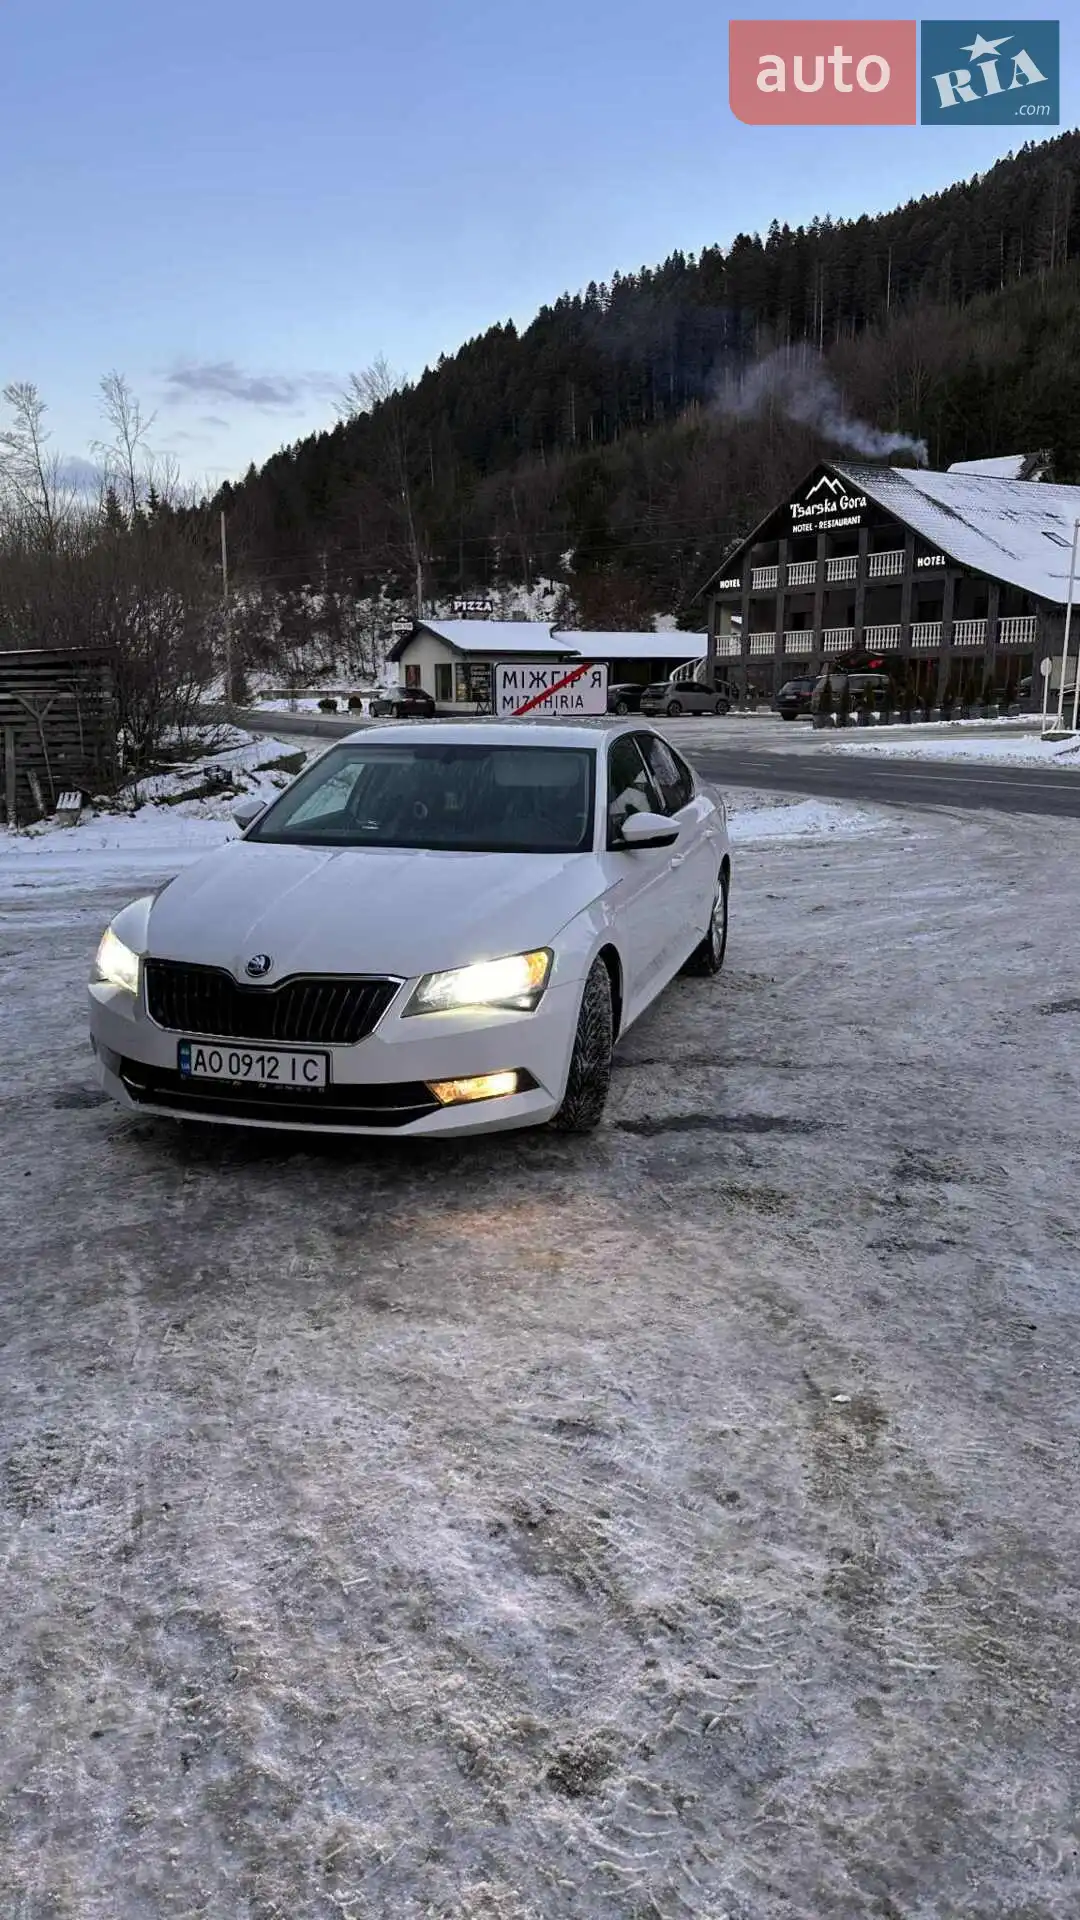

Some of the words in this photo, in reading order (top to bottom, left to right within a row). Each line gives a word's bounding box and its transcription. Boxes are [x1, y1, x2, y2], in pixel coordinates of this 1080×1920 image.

[790, 498, 837, 519] Tsarska
[839, 495, 867, 510] Gora
[792, 523, 813, 533] HOTEL
[818, 515, 861, 529] RESTAURANT
[917, 555, 946, 567] HOTEL
[719, 578, 741, 589] HOTEL
[453, 601, 492, 611] PIZZA
[193, 1049, 223, 1073] AO
[229, 1052, 279, 1079] 0912
[291, 1057, 319, 1082] IC
